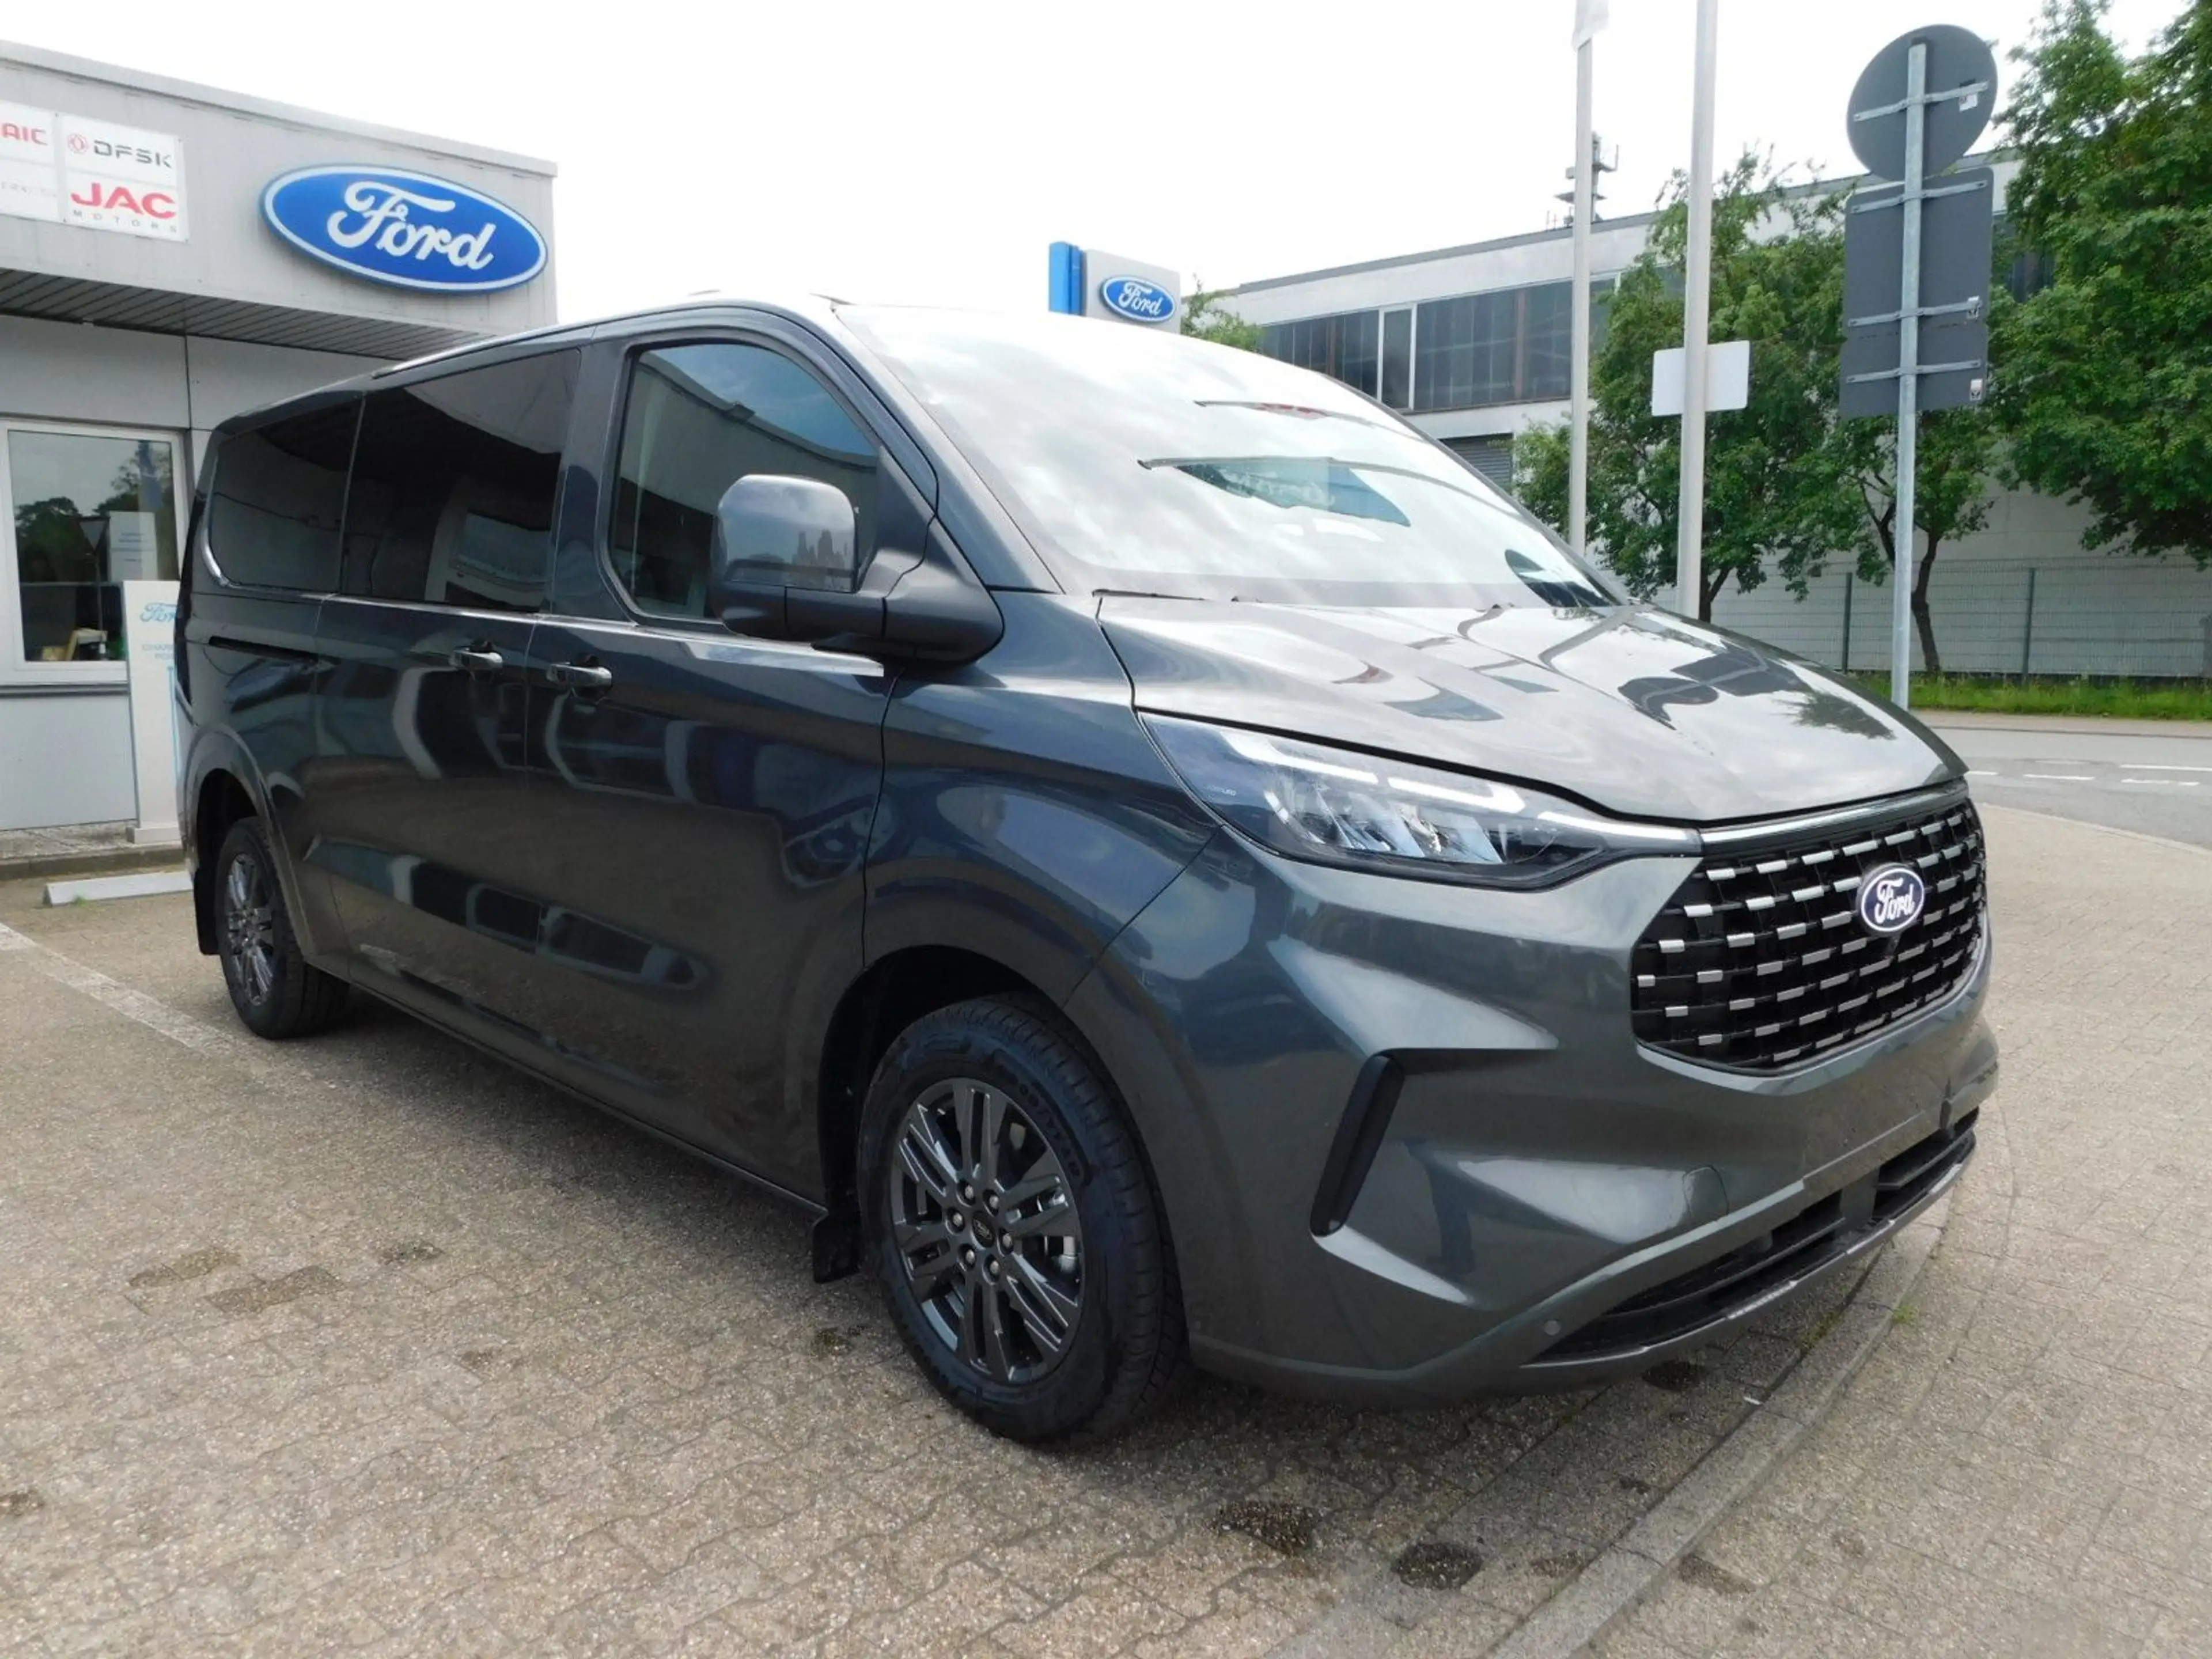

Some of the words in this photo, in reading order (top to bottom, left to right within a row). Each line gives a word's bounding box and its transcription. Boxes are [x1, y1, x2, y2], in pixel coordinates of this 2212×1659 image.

[94, 139, 173, 169] DFSK
[71, 183, 176, 219] JAC
[73, 209, 177, 233] MOTORS
[327, 181, 497, 271] Ford
[1118, 282, 1164, 316] Ford
[140, 602, 177, 622] For
[1874, 877, 1915, 924] Ford
